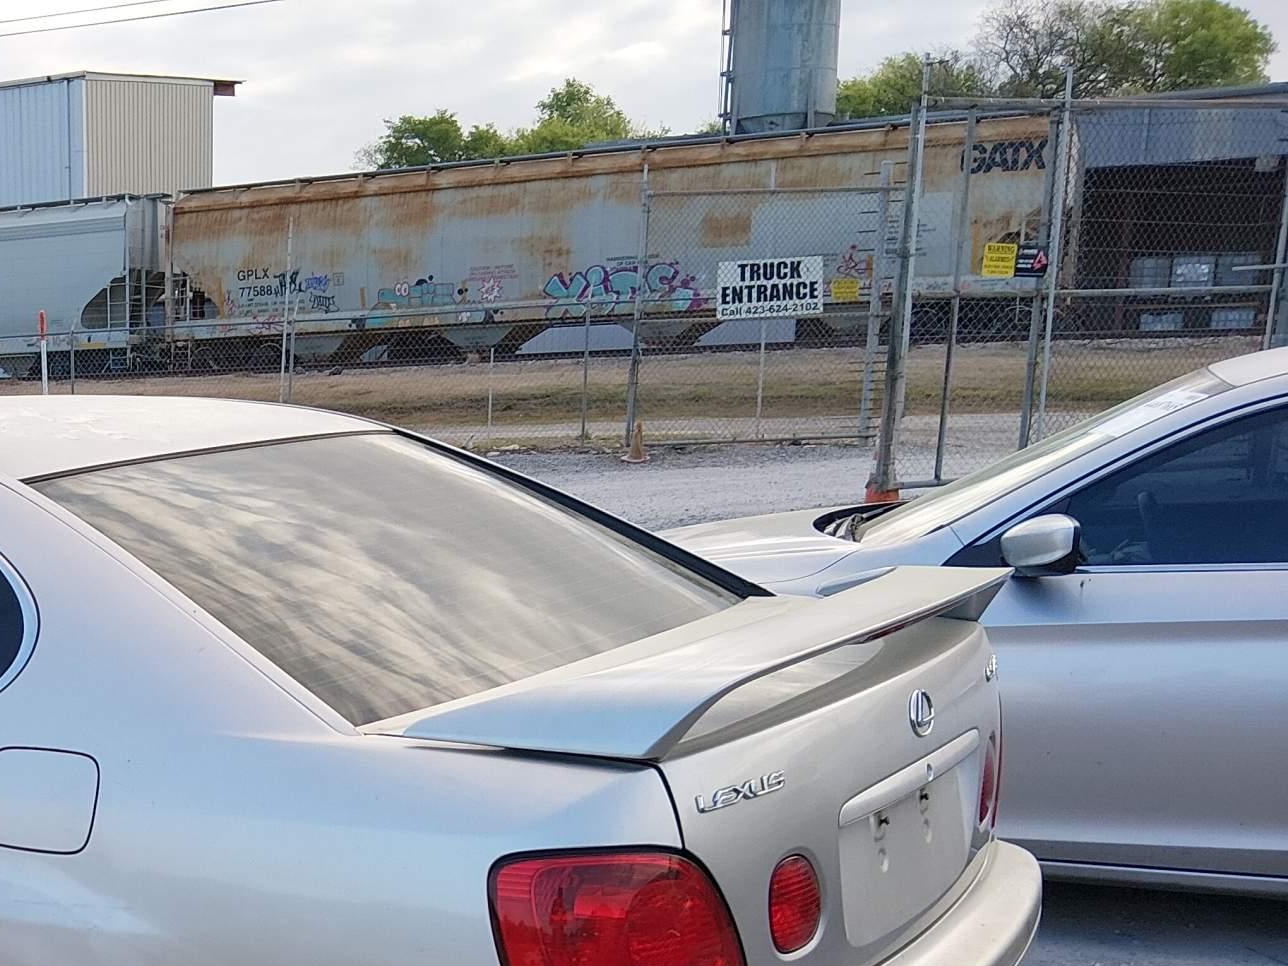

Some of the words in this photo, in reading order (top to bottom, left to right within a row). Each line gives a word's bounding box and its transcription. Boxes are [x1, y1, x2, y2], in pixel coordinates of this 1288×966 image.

[237, 267, 270, 281] GPLX
[738, 261, 802, 281] TRUCK
[721, 281, 818, 305] ENTRANCE
[745, 303, 819, 315] 423-624-2102
[695, 768, 786, 813] LEXUS
